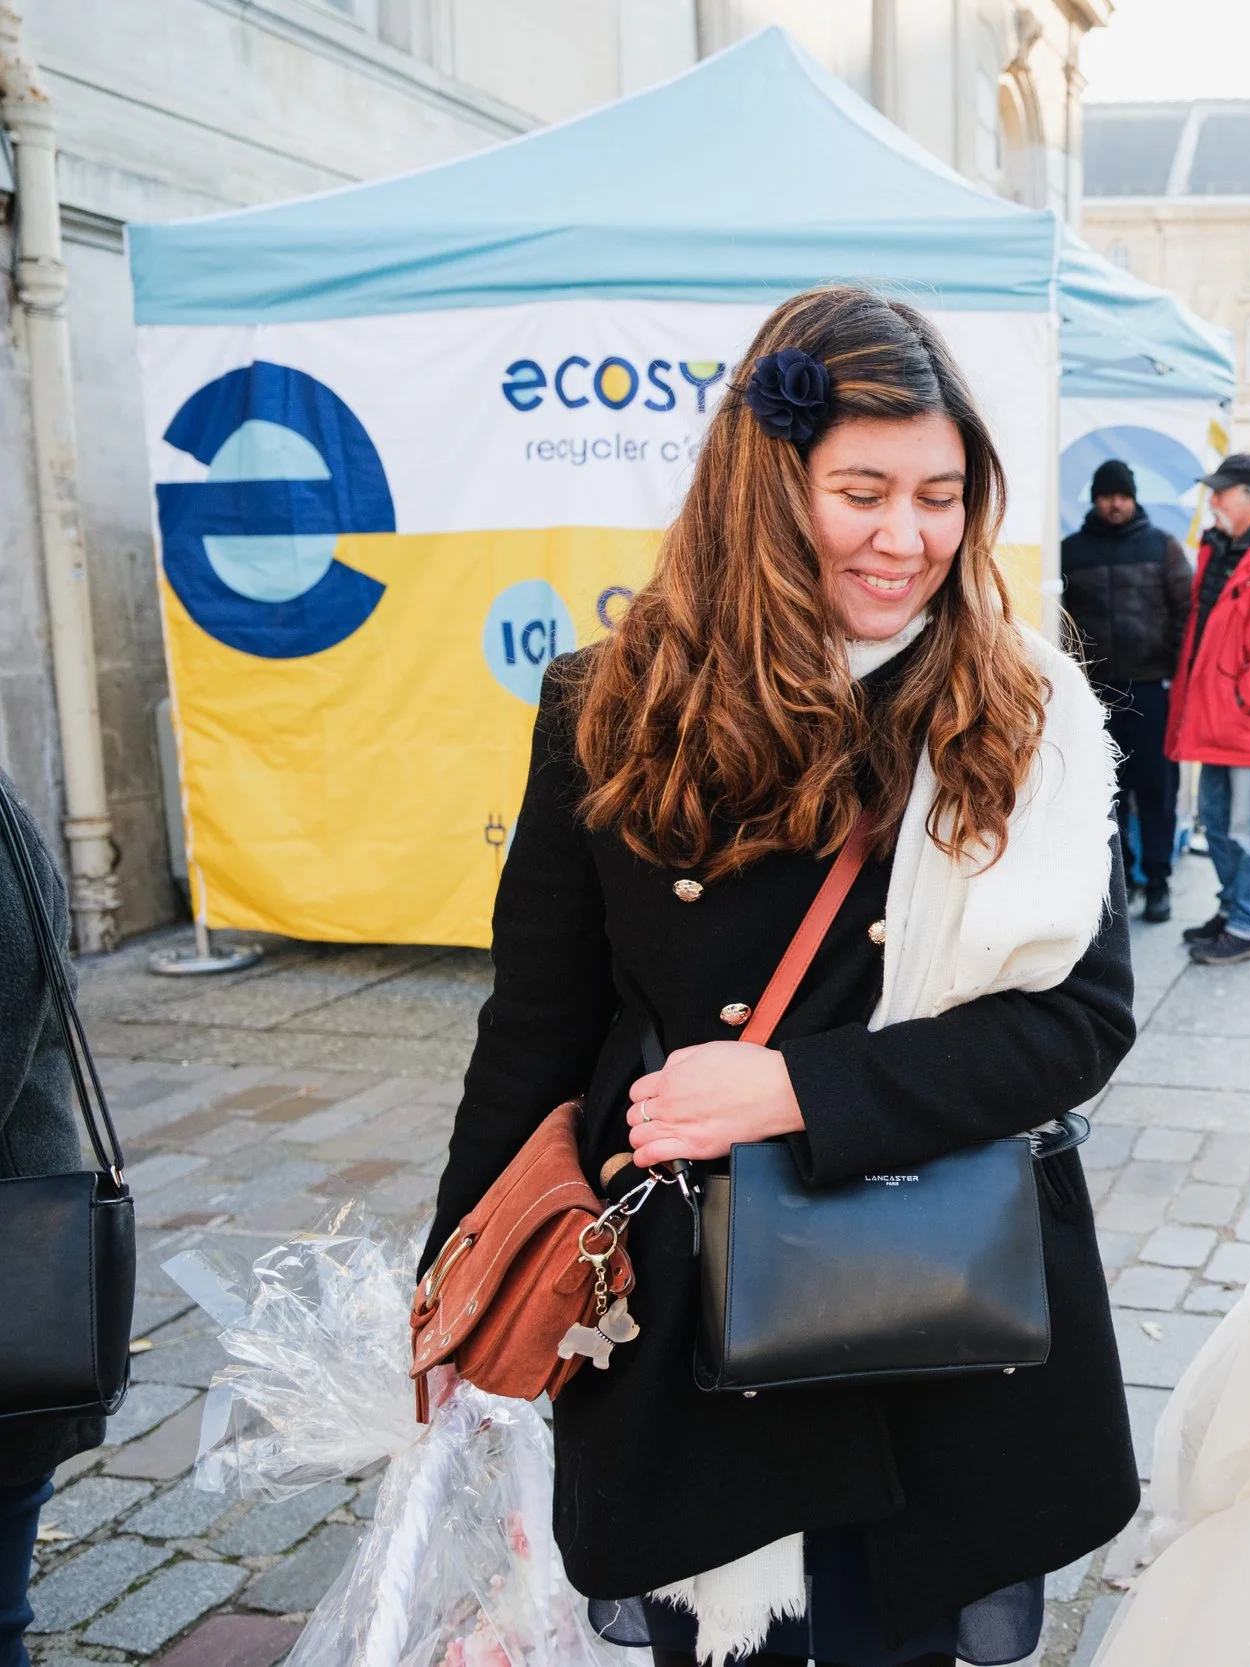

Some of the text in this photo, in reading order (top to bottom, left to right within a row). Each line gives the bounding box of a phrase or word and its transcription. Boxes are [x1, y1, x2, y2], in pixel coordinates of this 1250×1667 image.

[525, 432, 650, 466] recycler
[502, 618, 557, 665] ICI
[864, 1174, 920, 1182] LANCASTER
